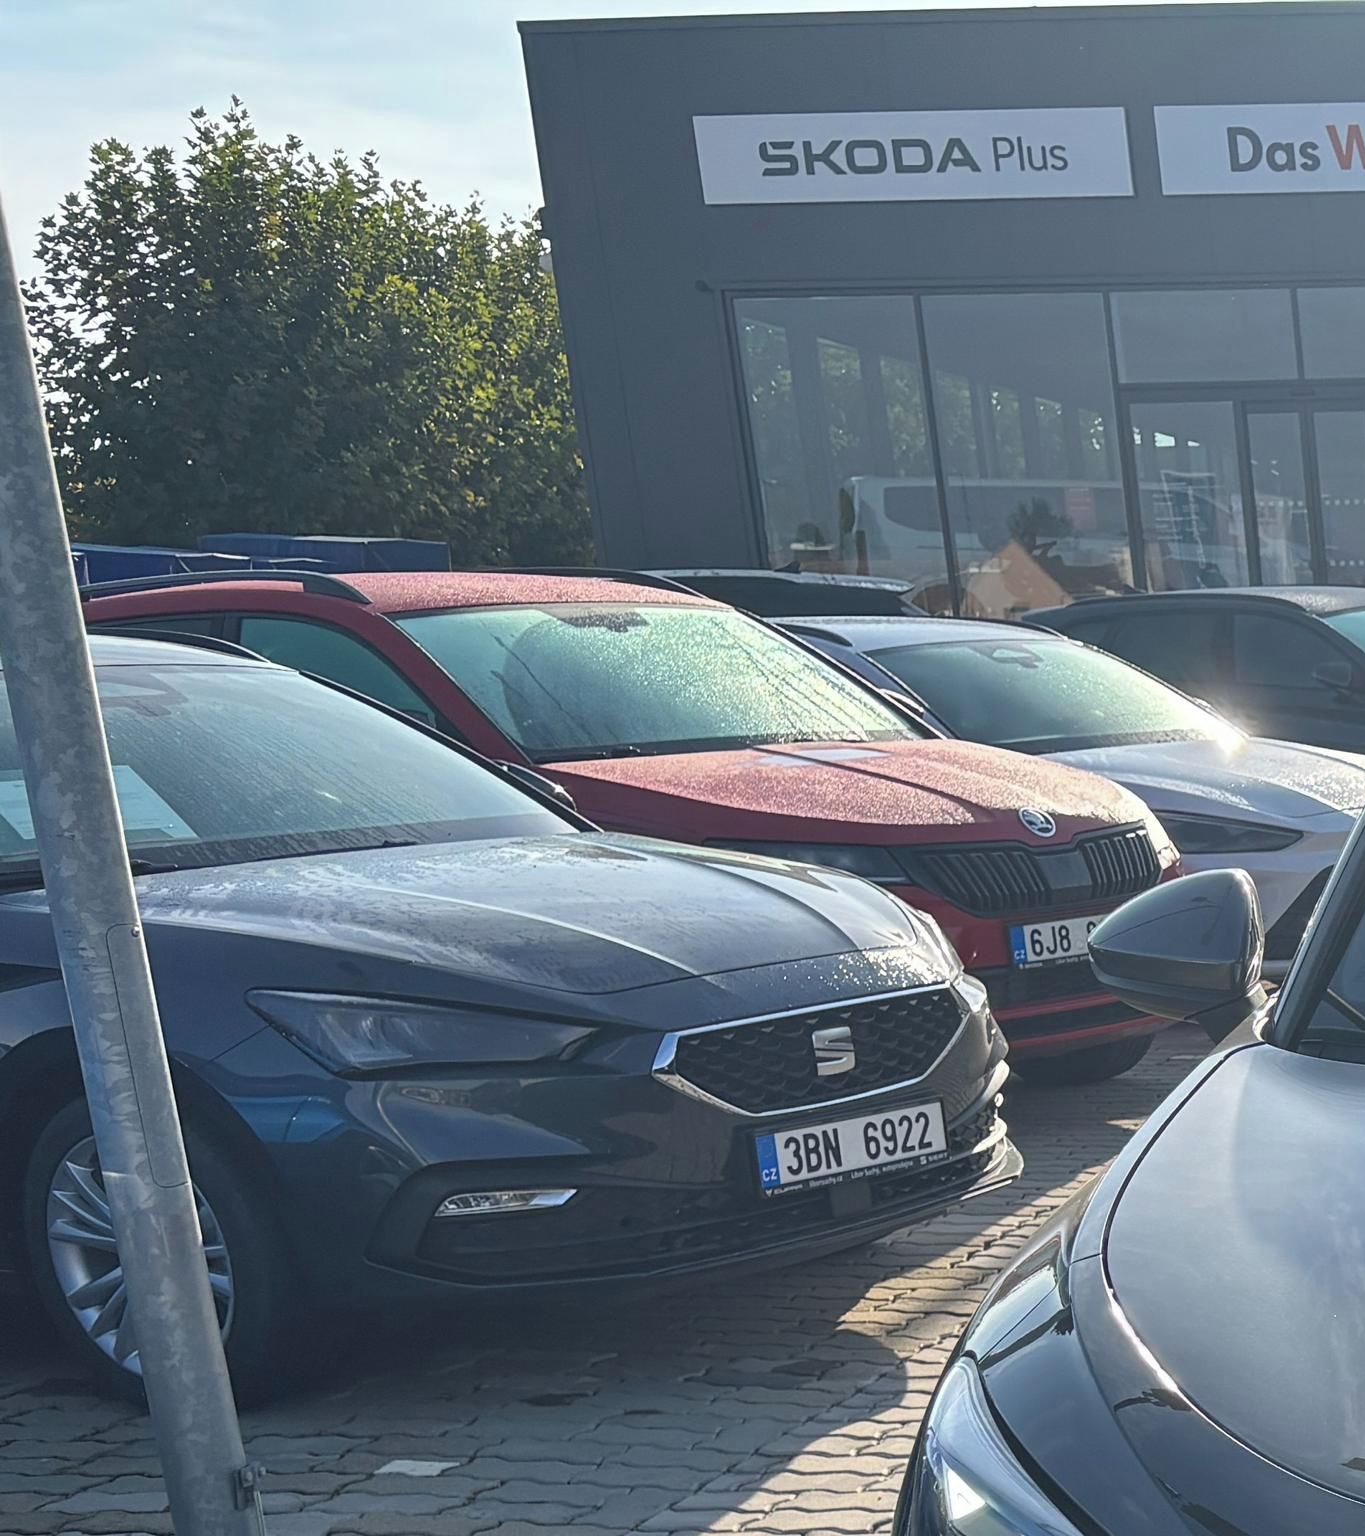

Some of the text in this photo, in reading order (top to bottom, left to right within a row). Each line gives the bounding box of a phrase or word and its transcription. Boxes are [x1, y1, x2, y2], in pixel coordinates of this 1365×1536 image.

[991, 135, 1069, 172] Plus
[1226, 126, 1321, 172] Das
[1014, 950, 1025, 960] CZ
[1030, 925, 1071, 957] 6J8
[784, 1111, 933, 1176] 3BN 6922
[762, 1167, 778, 1182] CZ
